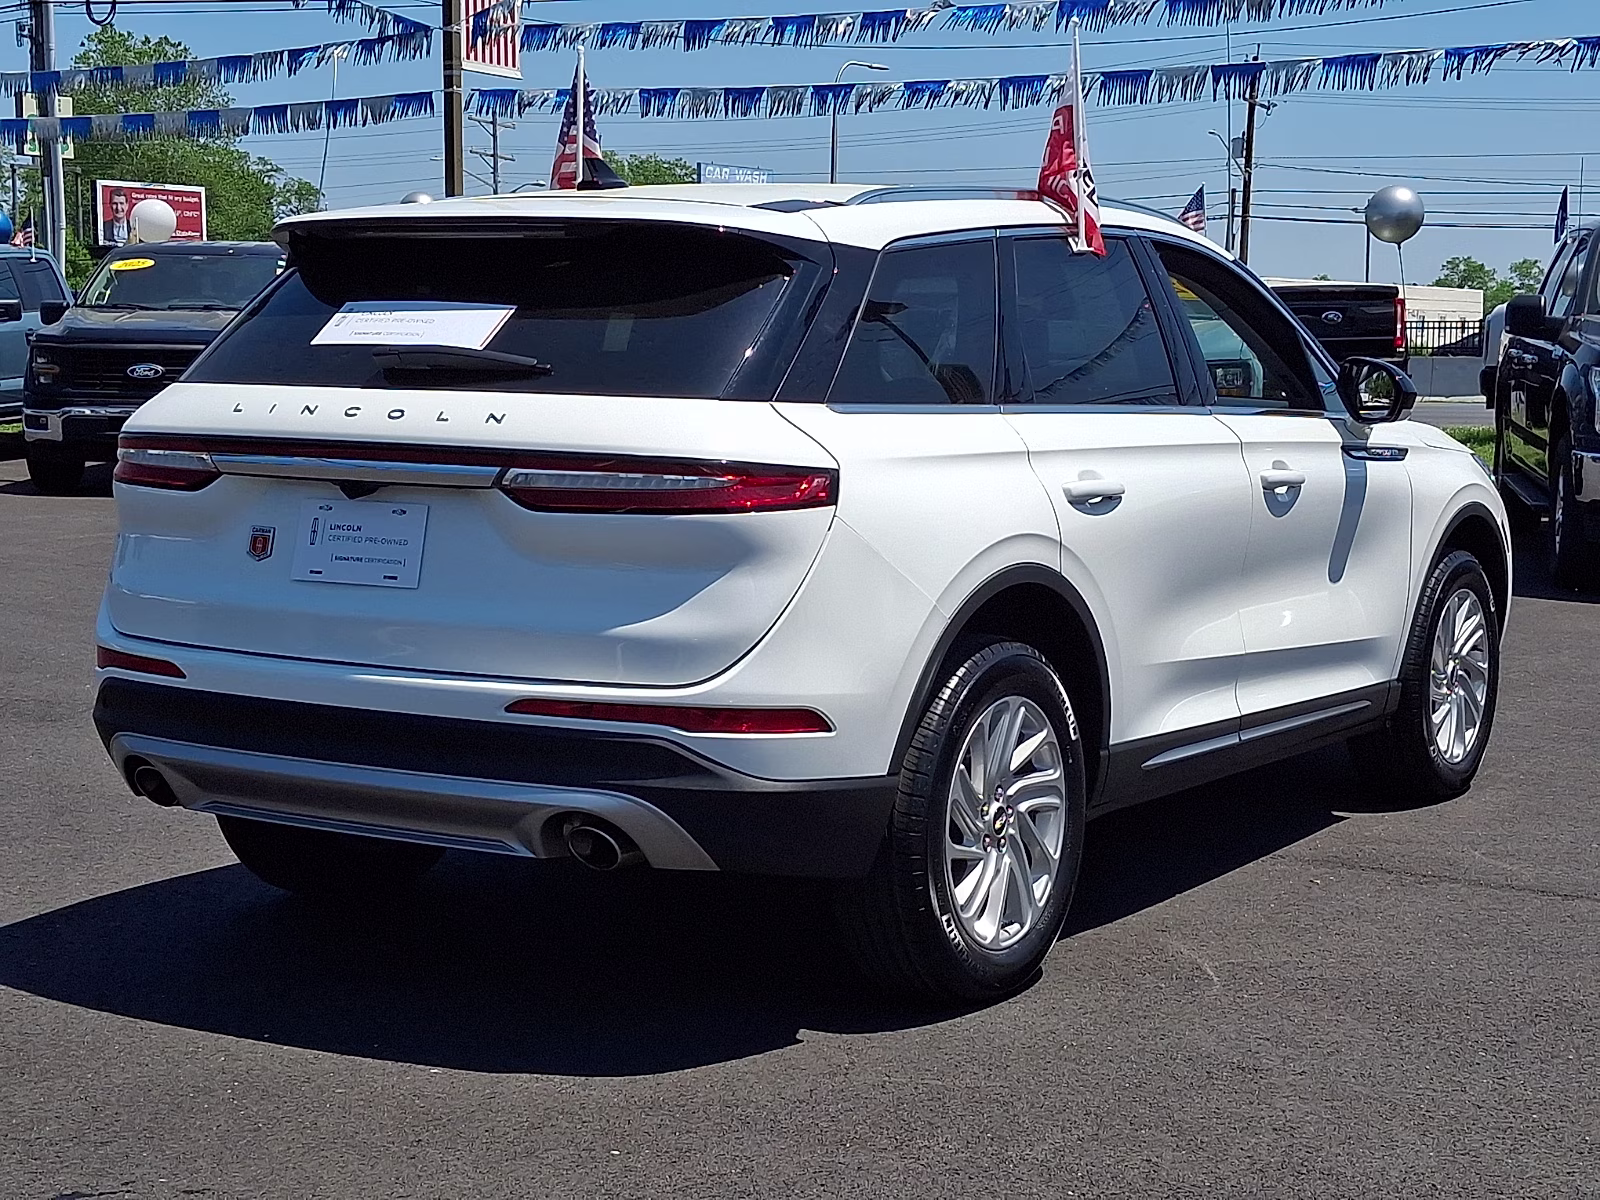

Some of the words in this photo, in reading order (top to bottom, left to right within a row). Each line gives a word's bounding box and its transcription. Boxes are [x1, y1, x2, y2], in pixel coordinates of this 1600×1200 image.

[705, 166, 730, 180] CAR
[735, 169, 768, 184] WASH
[232, 402, 507, 425] LINCOLN
[329, 523, 363, 533] LINCOLN
[327, 534, 363, 544] CERTIFIED
[363, 536, 409, 547] PRE-OWNED
